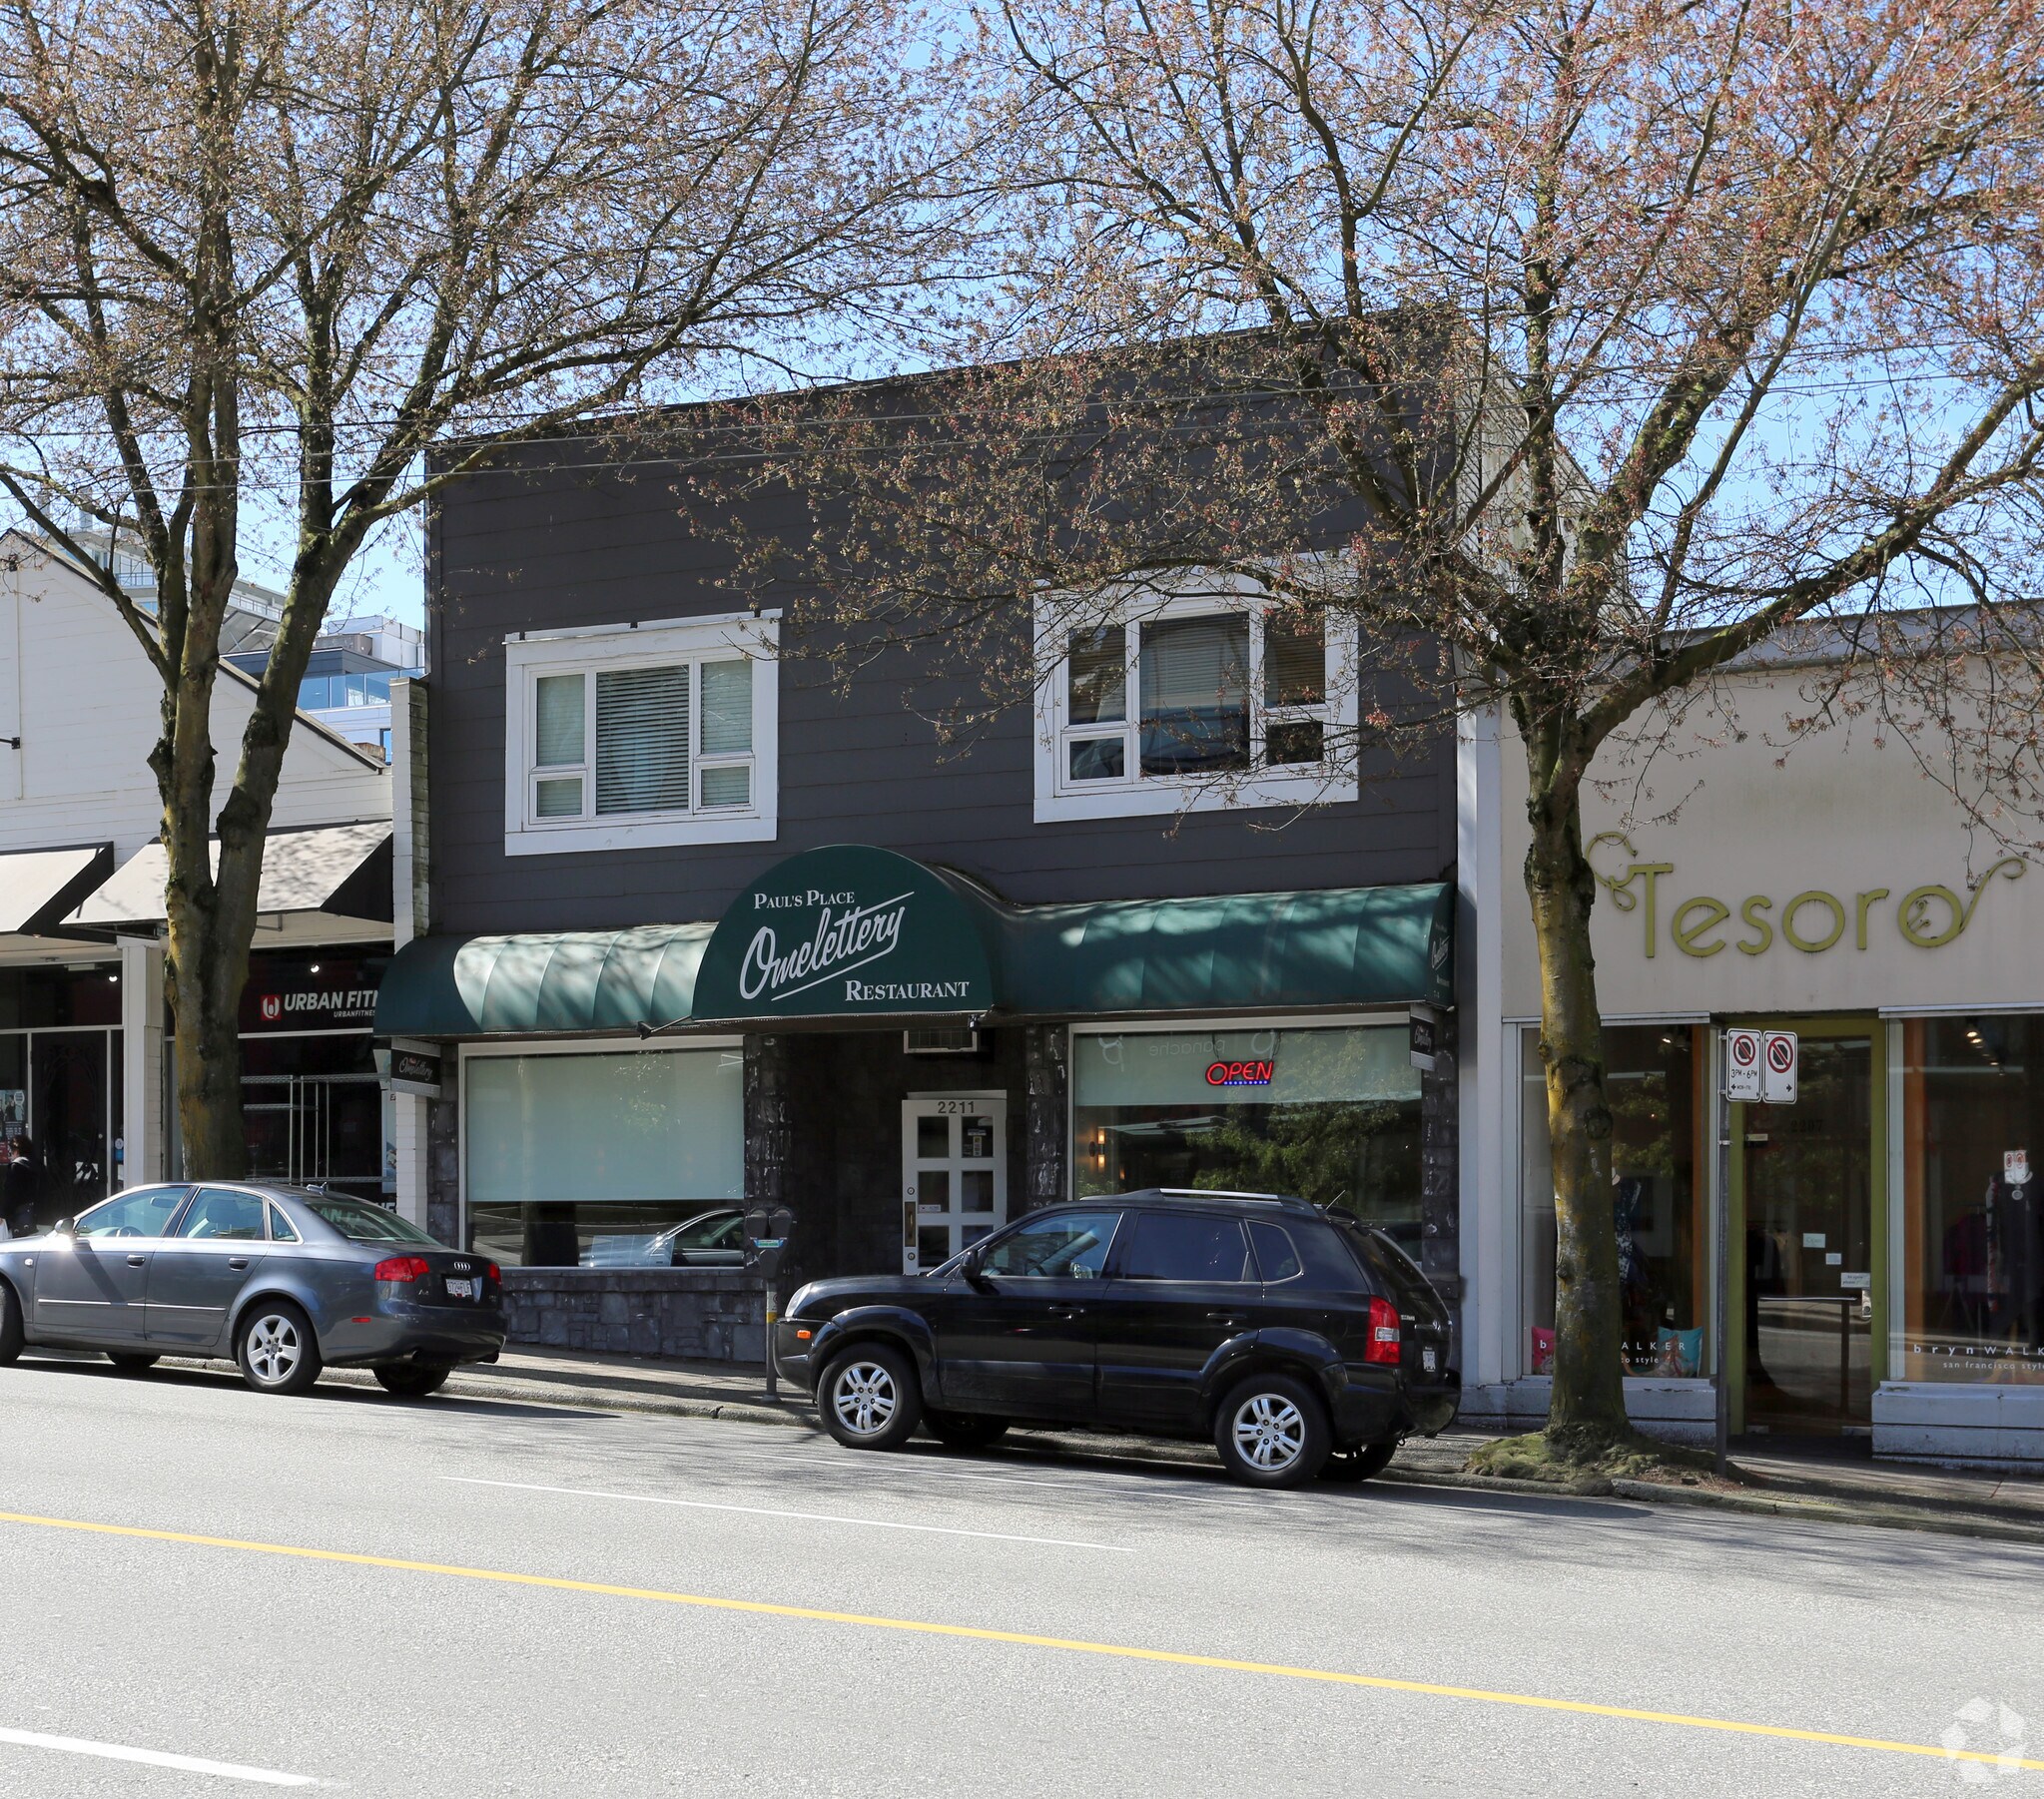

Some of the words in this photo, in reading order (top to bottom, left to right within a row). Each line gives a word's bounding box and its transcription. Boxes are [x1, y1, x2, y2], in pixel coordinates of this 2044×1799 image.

[806, 890, 856, 905] PLACE
[1586, 832, 2027, 957] Tesoro
[739, 891, 916, 1001] Omelettery
[845, 979, 971, 1001] RESTAURANT
[284, 991, 343, 1011] URBAN
[1206, 1061, 1274, 1085] OPEN
[938, 1101, 975, 1114] 2211
[1965, 1361, 2016, 1370] francisco
